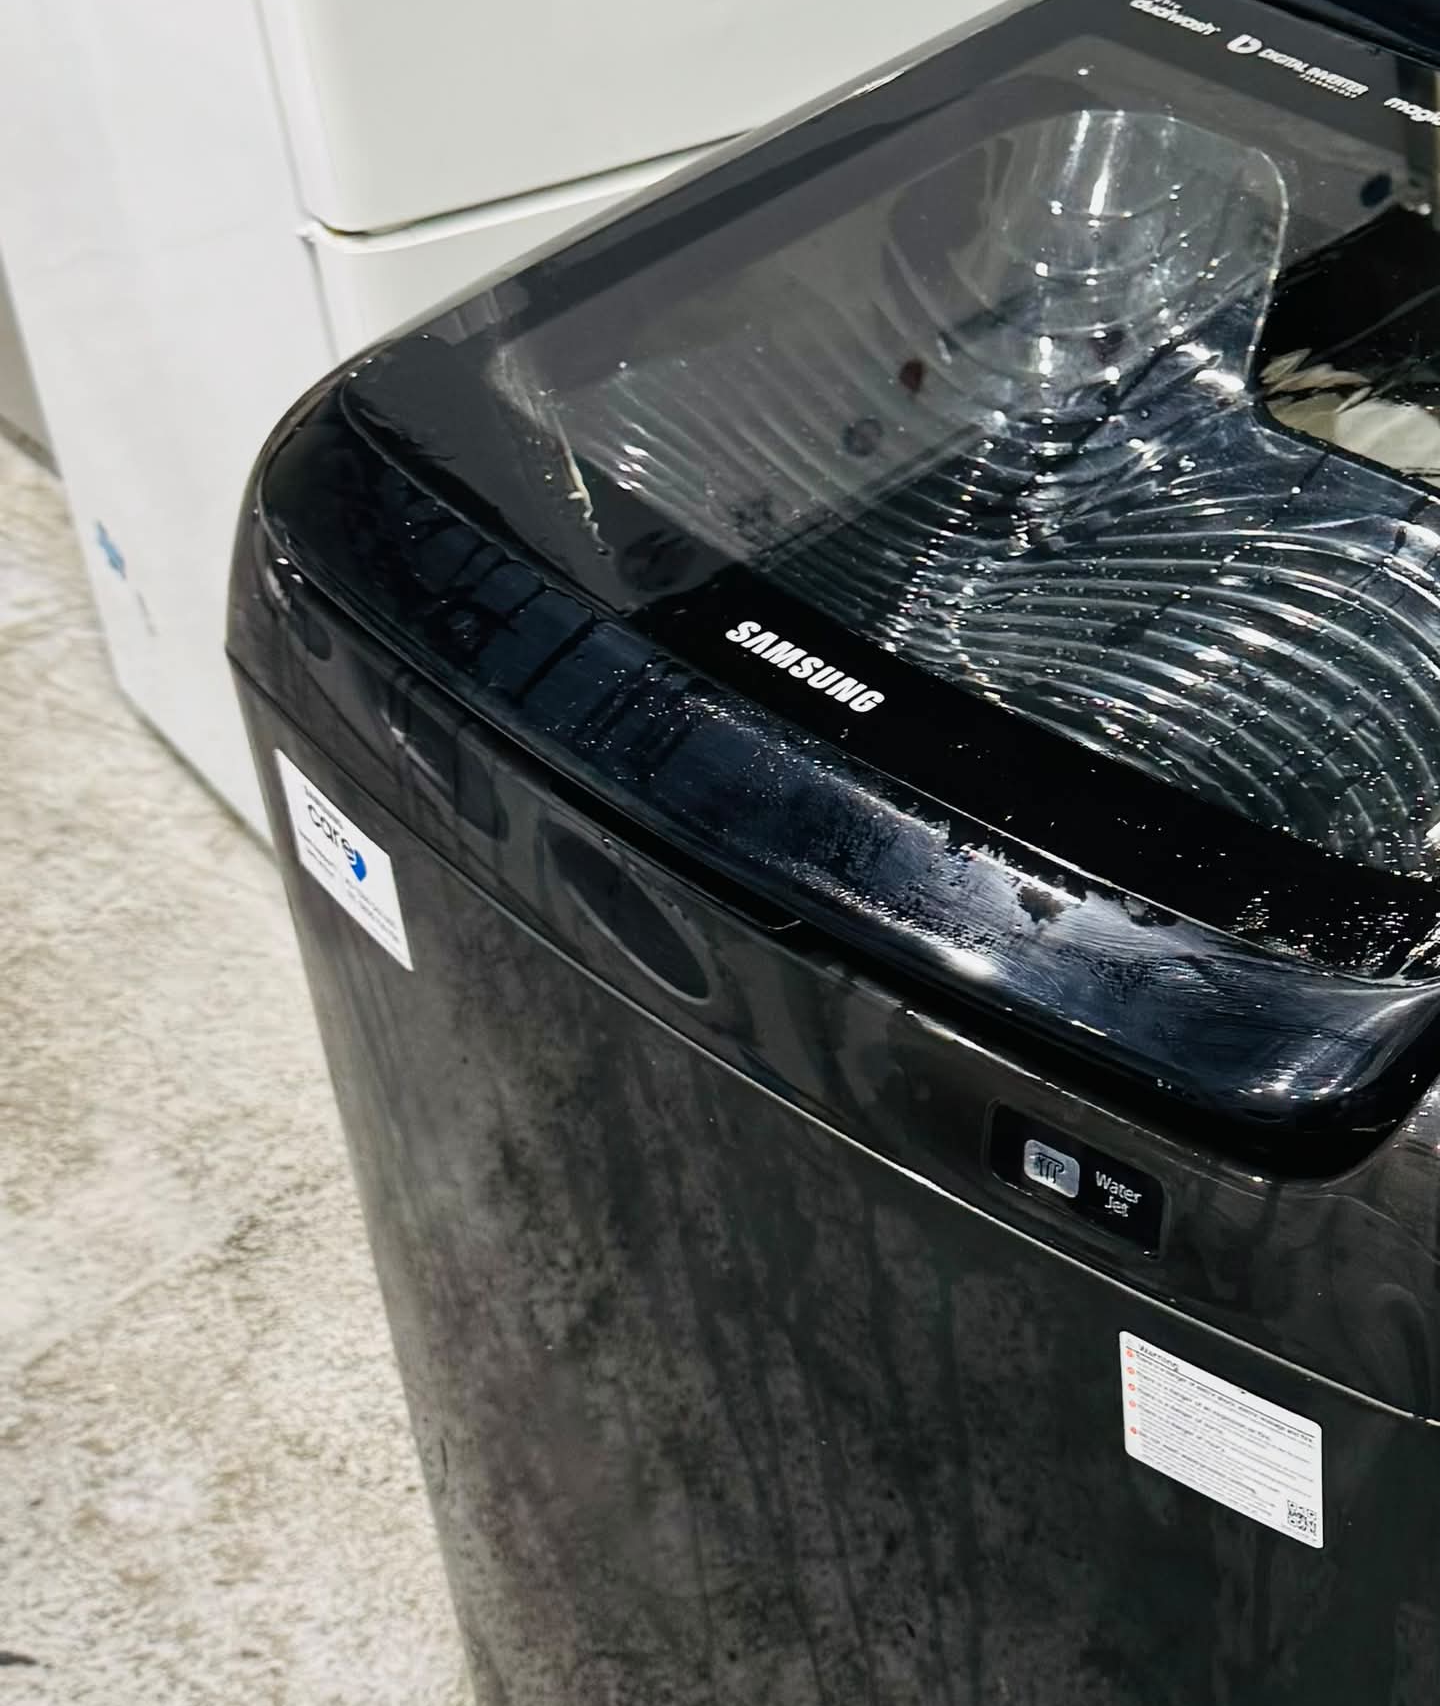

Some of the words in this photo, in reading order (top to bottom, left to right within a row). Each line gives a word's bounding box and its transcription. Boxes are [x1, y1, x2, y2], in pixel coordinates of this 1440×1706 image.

[1258, 48, 1309, 73] DIGITAL
[1305, 67, 1369, 94] INVERTER
[725, 621, 885, 713] SAMSUNG
[1095, 1171, 1142, 1204] Water
[1104, 1195, 1129, 1218] Jet
